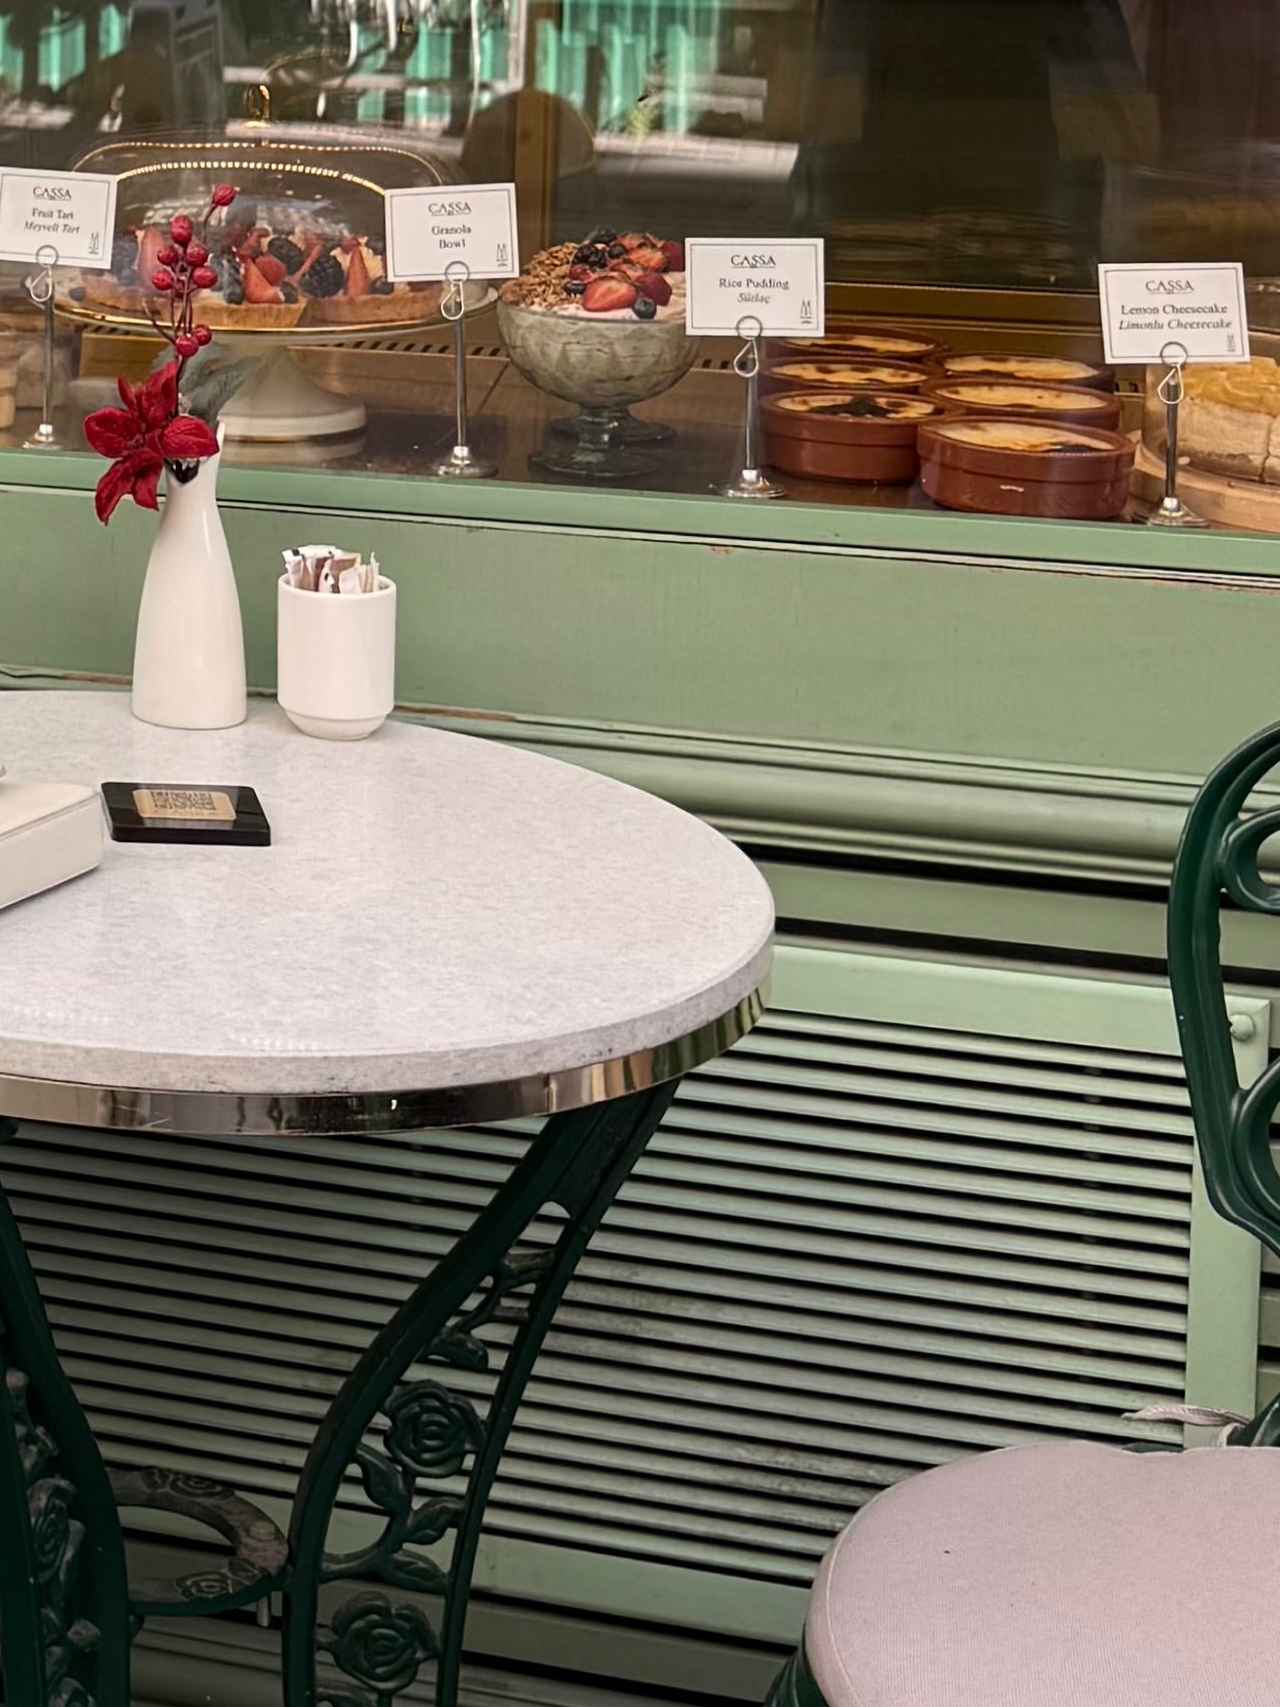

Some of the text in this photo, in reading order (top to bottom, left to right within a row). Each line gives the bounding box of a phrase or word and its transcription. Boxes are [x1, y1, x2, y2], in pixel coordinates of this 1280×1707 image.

[32, 186, 72, 200] CASSA
[31, 207, 74, 220] Fruit Tart
[428, 202, 472, 216] CASSA
[23, 221, 80, 234] Meyveli Tart
[431, 224, 472, 235] Granola
[439, 239, 465, 249] Bowl
[730, 254, 776, 268] CASSA
[719, 277, 789, 290] Rice Pudding
[1145, 280, 1195, 294] CASSA
[1121, 303, 1227, 315] Lemon Cheesecake
[1119, 318, 1232, 330] Limonlu Cheesecake
